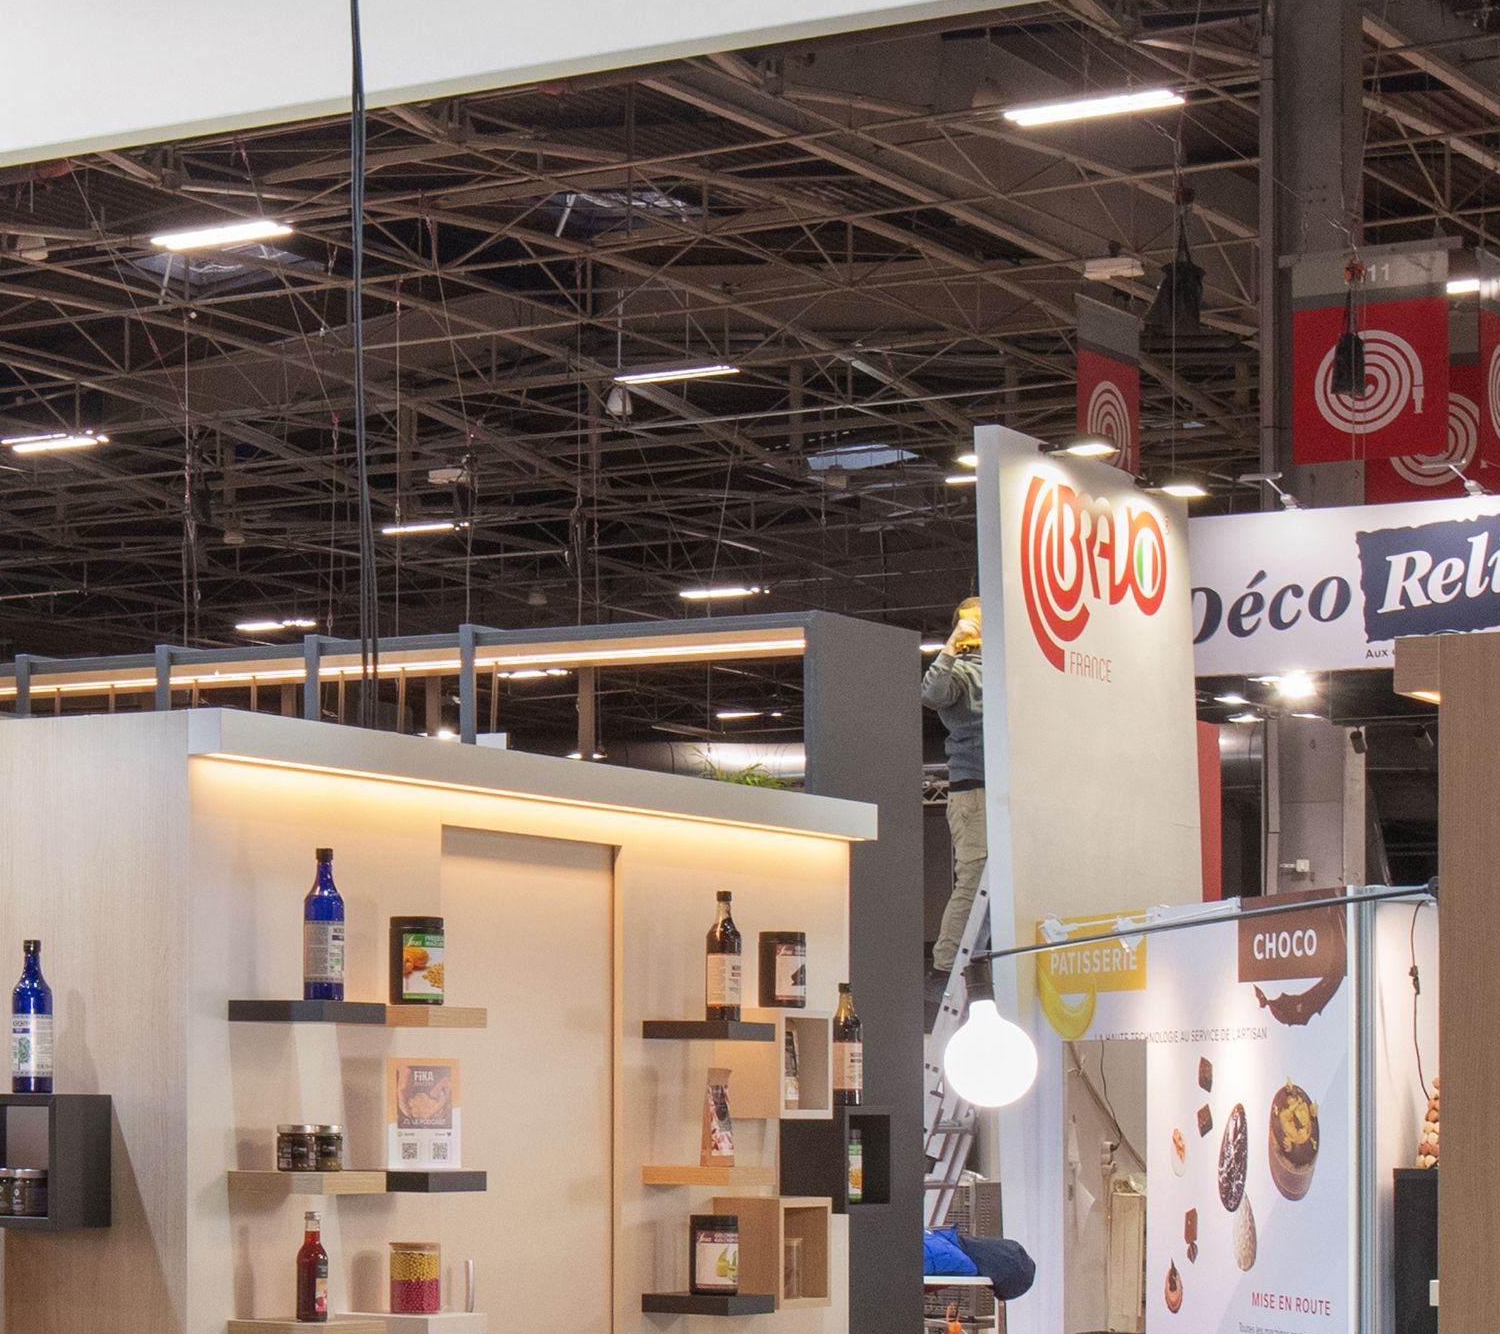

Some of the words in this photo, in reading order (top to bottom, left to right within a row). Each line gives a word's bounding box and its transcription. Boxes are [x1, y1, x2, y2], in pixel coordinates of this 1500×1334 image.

[1366, 648, 1388, 660] Aux
[1070, 652, 1112, 683] FRANCE
[1254, 929, 1316, 960] CHOCO
[1191, 1029, 1219, 1042] SERVICE
[1252, 1292, 1275, 1309] MISE
[1279, 1295, 1292, 1311] EN
[1296, 1297, 1331, 1316] ROUTE
